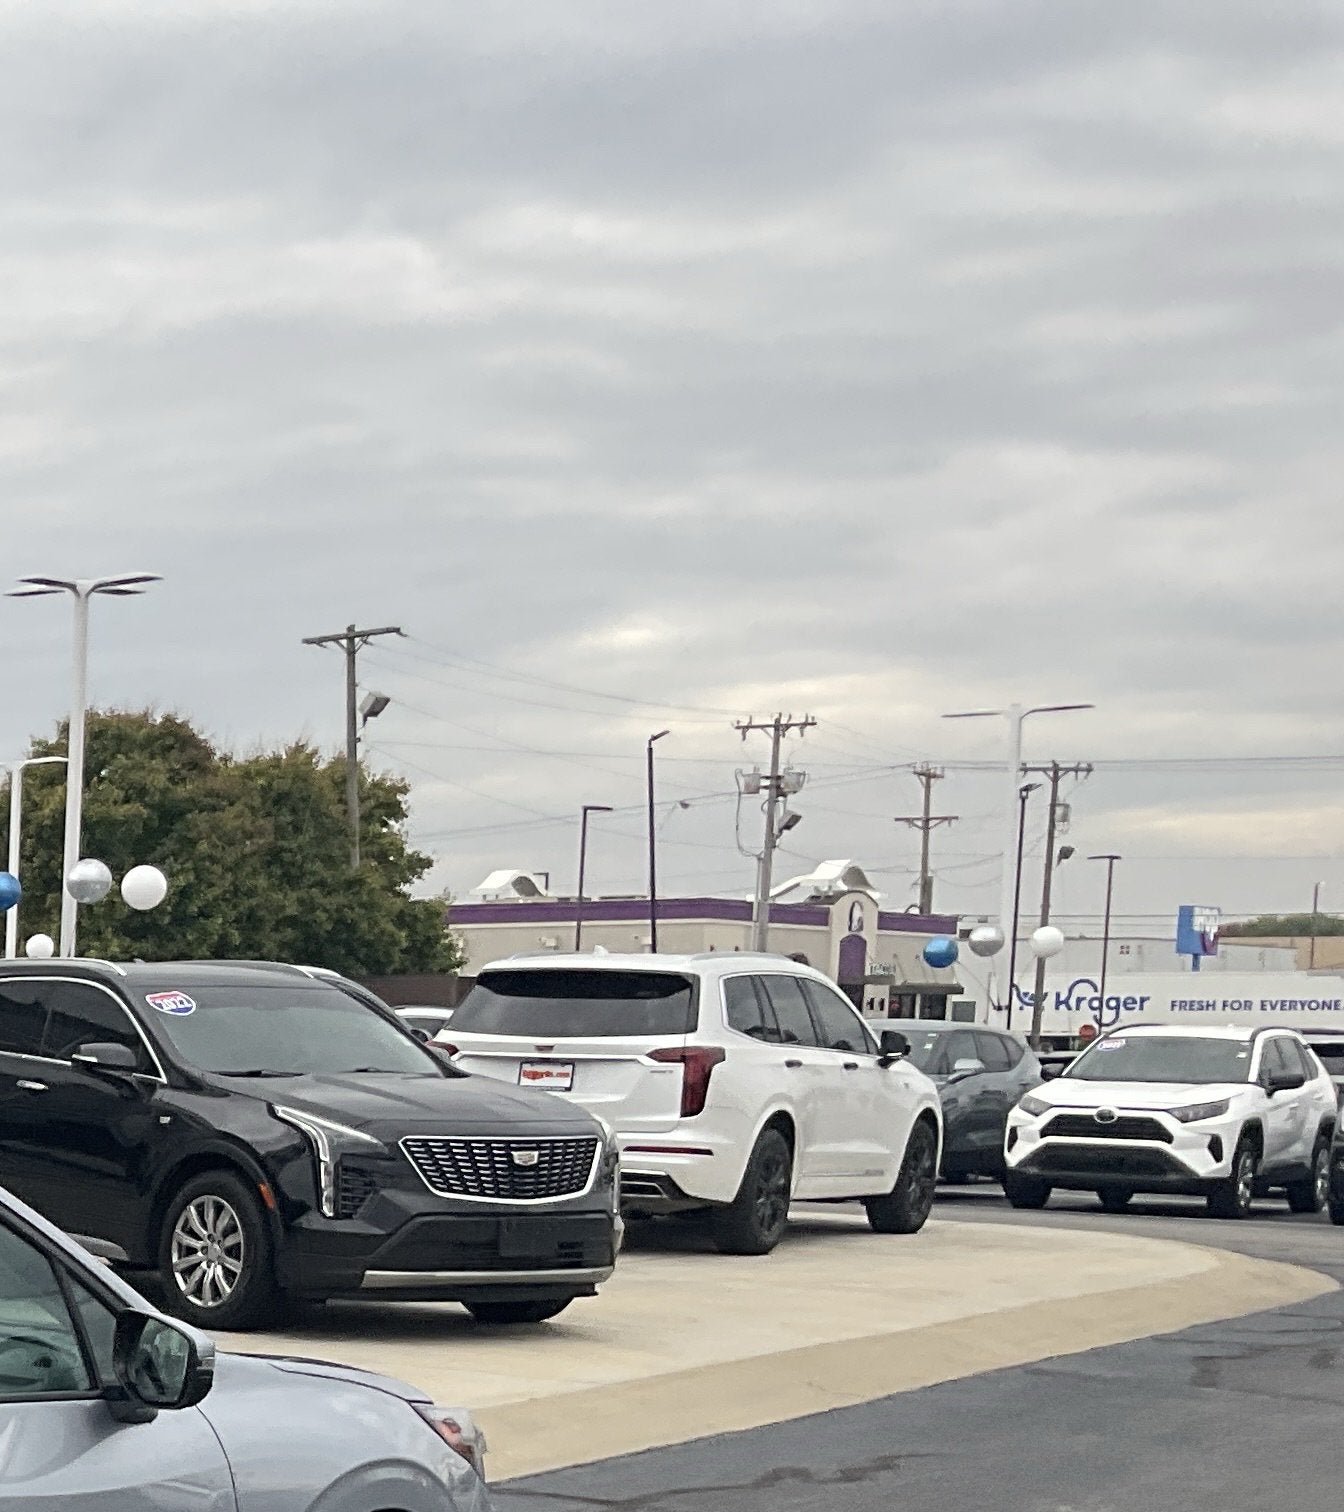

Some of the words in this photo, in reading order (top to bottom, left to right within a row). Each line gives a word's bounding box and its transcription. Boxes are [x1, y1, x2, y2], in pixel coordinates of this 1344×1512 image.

[1054, 979, 1151, 1027] Kroger
[1170, 999, 1216, 1012] FRESH
[1222, 999, 1253, 1012] FOR
